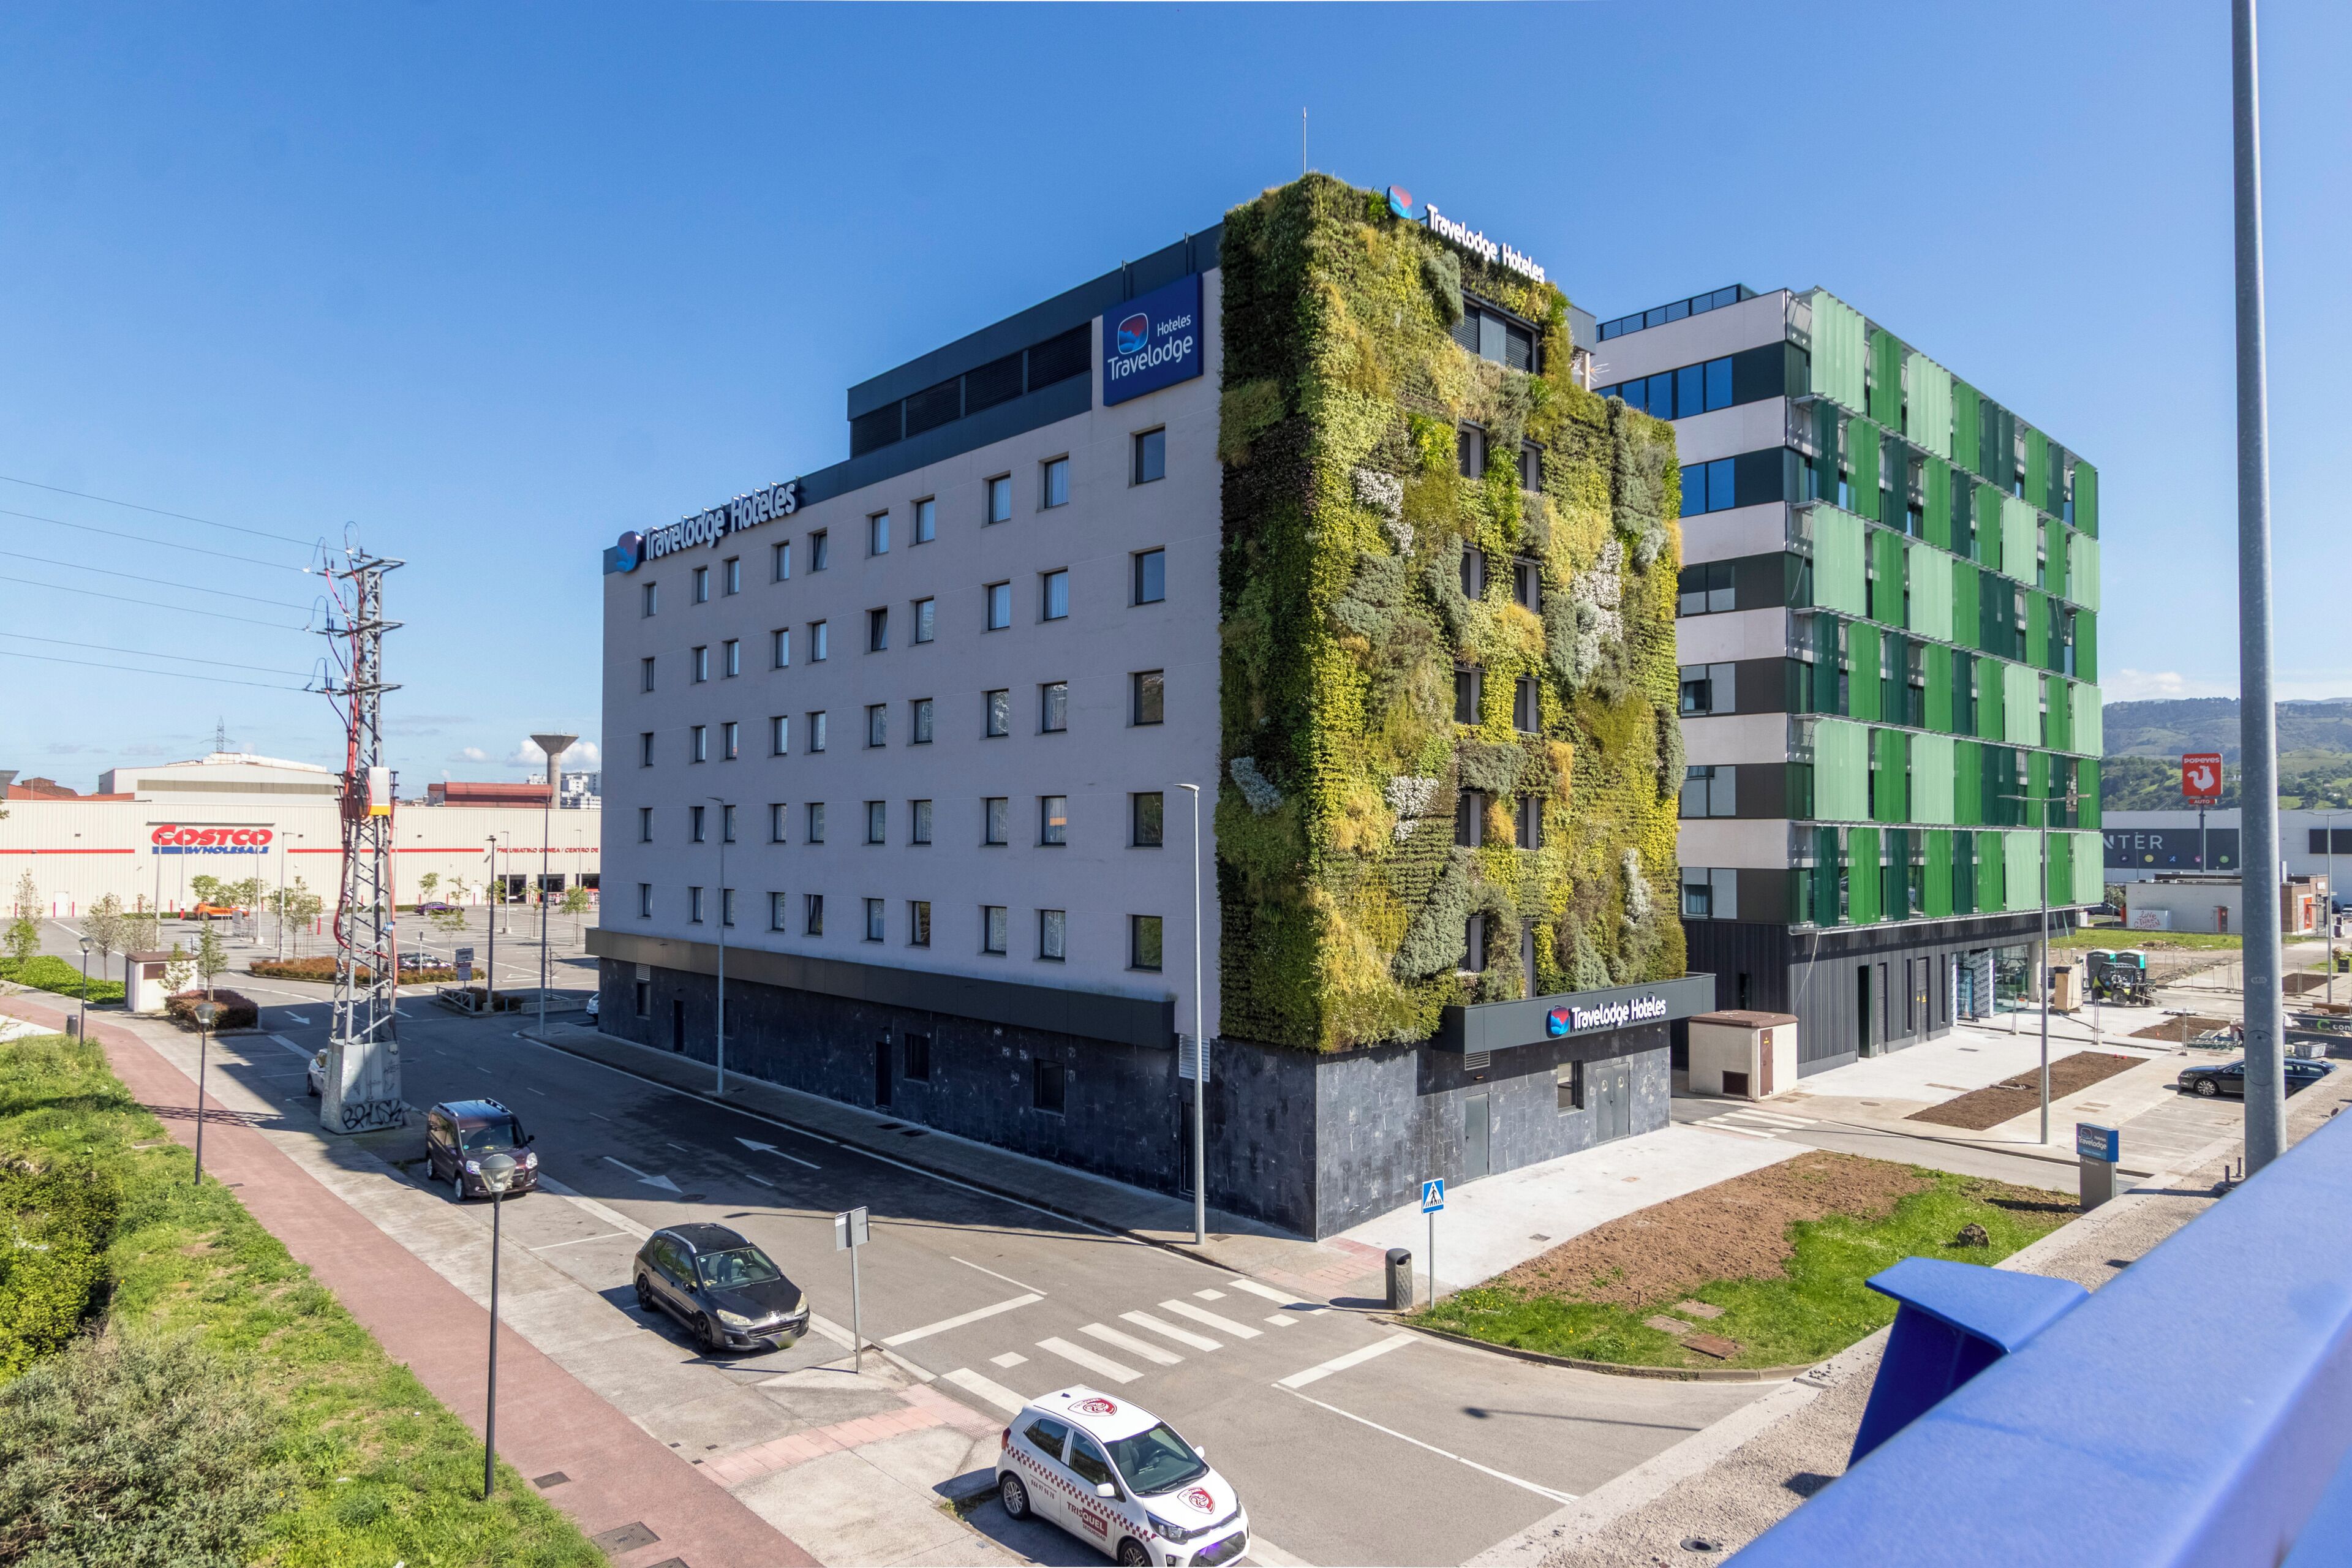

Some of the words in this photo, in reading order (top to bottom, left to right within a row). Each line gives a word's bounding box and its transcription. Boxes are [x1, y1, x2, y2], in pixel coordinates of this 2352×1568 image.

[1427, 203, 1498, 262] Travelodge
[1502, 243, 1545, 284] Hoteles
[1157, 315, 1191, 337] Hoteles
[1107, 336, 1193, 380] Travelodge
[644, 507, 726, 561] Travelodge
[731, 481, 796, 532] Hoteles
[151, 824, 273, 845] COSTCO
[1572, 1003, 1629, 1029] Travelodge
[1631, 996, 1666, 1020] Hoteles
[2078, 1136, 2107, 1150] Travelodge
[1067, 1501, 1104, 1531] TRISQUEL
[1082, 1523, 1106, 1542] SEGURIDAD
